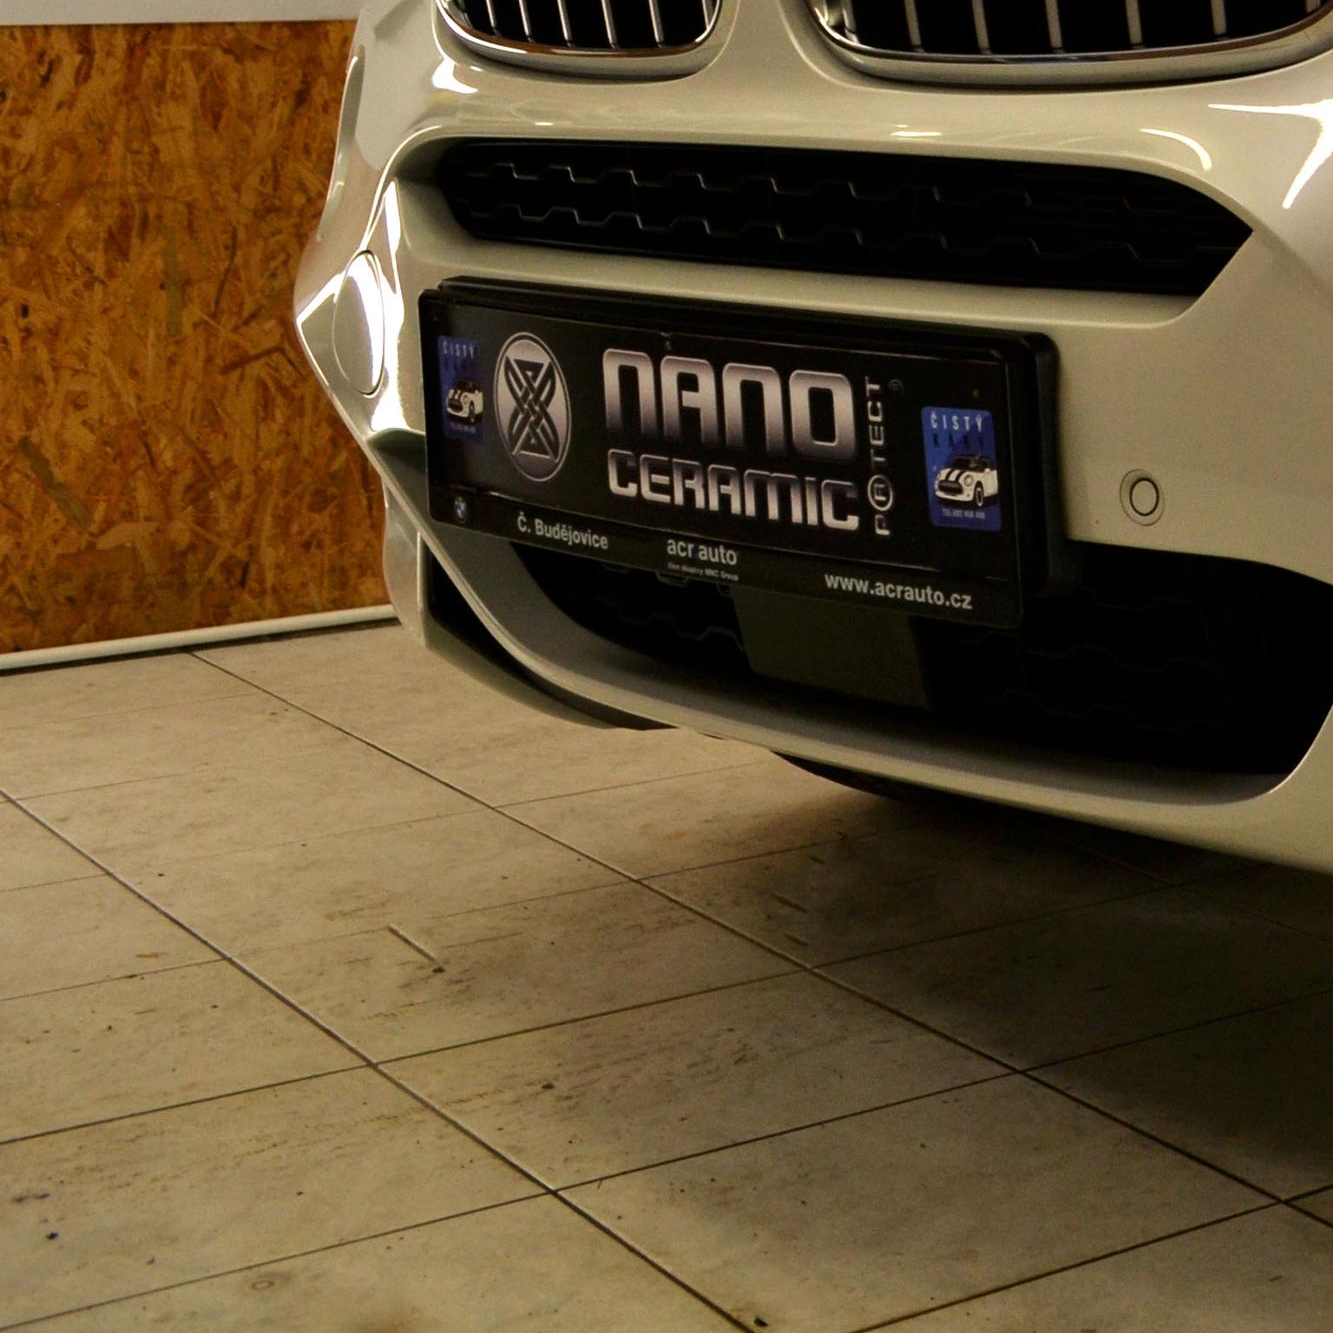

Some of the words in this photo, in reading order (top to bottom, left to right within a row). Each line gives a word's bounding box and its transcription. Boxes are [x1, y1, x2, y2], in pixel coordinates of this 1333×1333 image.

[602, 348, 857, 462] NANO
[607, 448, 860, 532] CERAMIC
[516, 511, 531, 533] Č.
[534, 518, 609, 550] Budějovice
[667, 538, 693, 559] acr
[698, 544, 738, 566] auto
[824, 573, 973, 610] www.acrauto.cz
